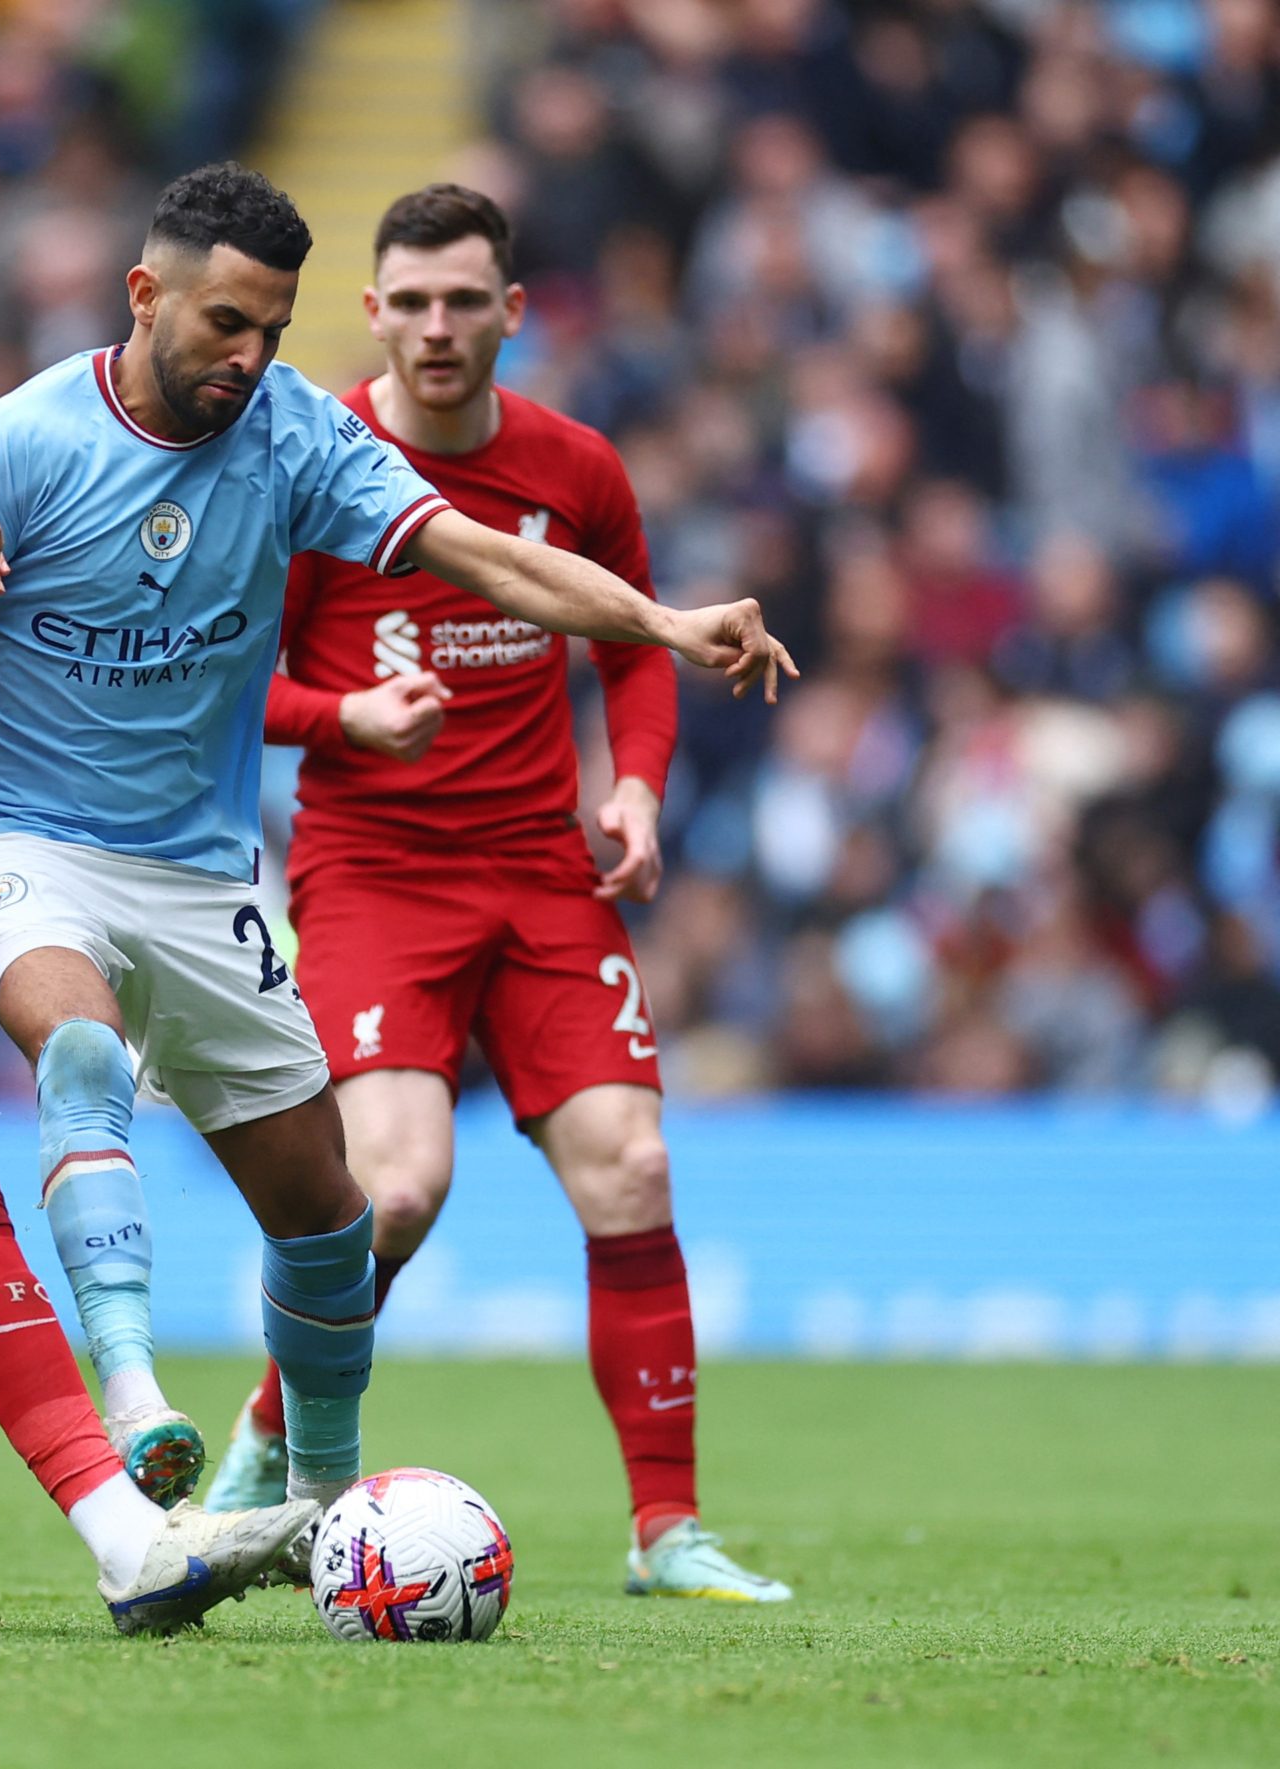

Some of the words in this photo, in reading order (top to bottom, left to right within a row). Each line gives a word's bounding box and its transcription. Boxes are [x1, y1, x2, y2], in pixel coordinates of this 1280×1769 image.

[31, 610, 248, 662] ETIHAD
[65, 657, 209, 688] AIRWAYS
[233, 905, 288, 994] 2
[85, 1222, 142, 1248] CITY
